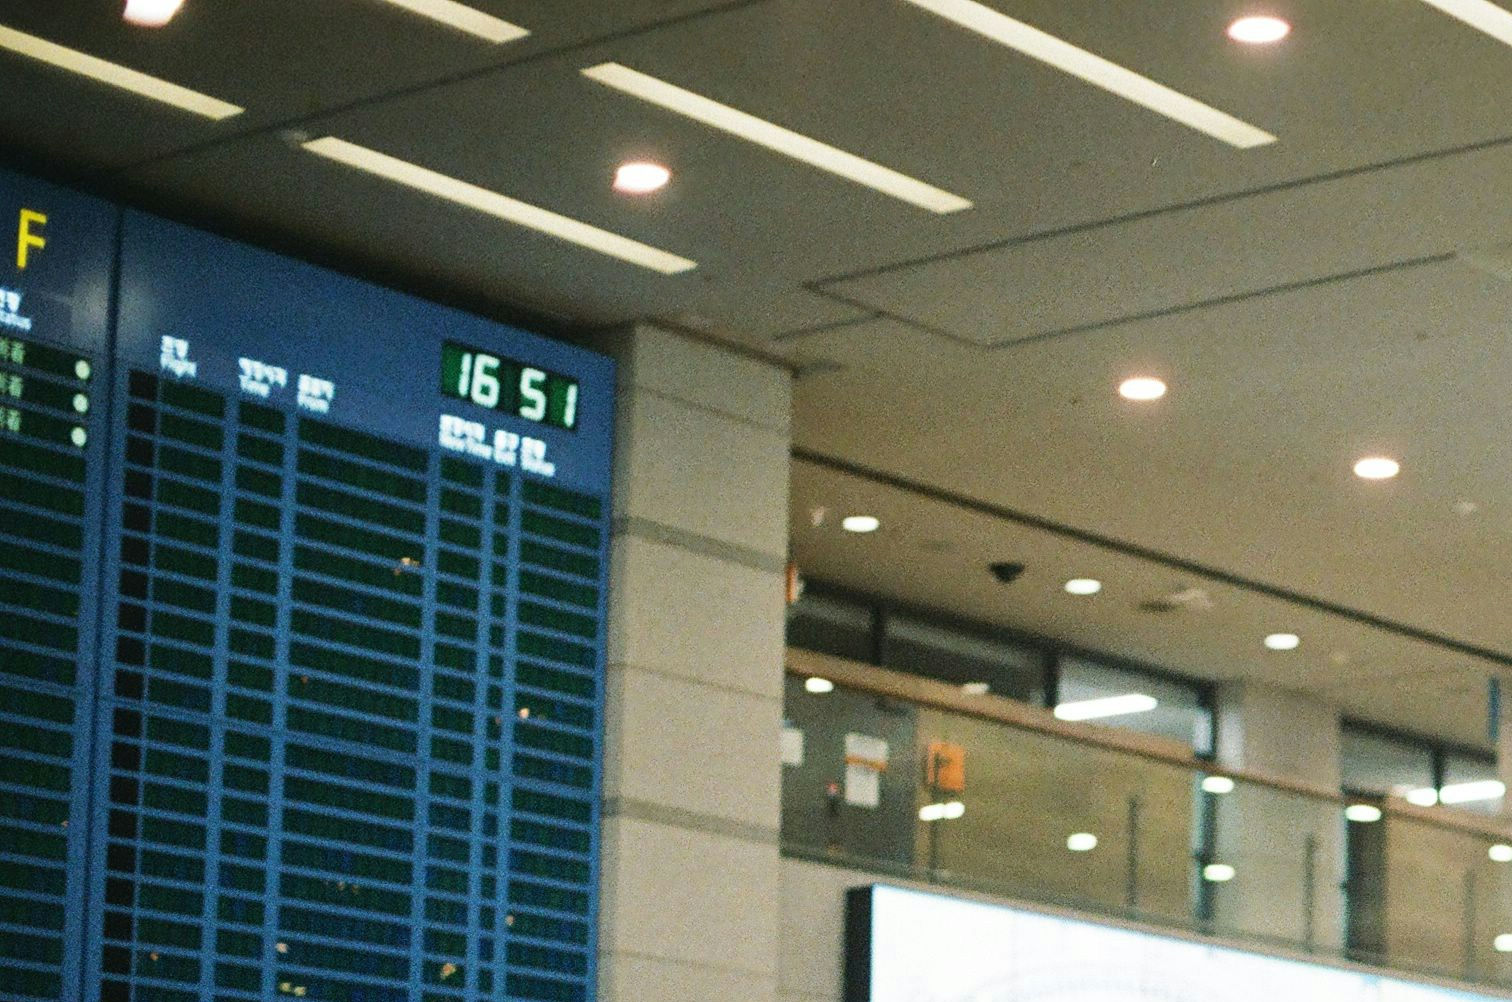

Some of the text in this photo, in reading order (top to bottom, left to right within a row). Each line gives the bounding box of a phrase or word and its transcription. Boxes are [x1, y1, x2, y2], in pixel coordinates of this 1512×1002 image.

[16, 208, 47, 269] F
[458, 353, 578, 428] 16 51
